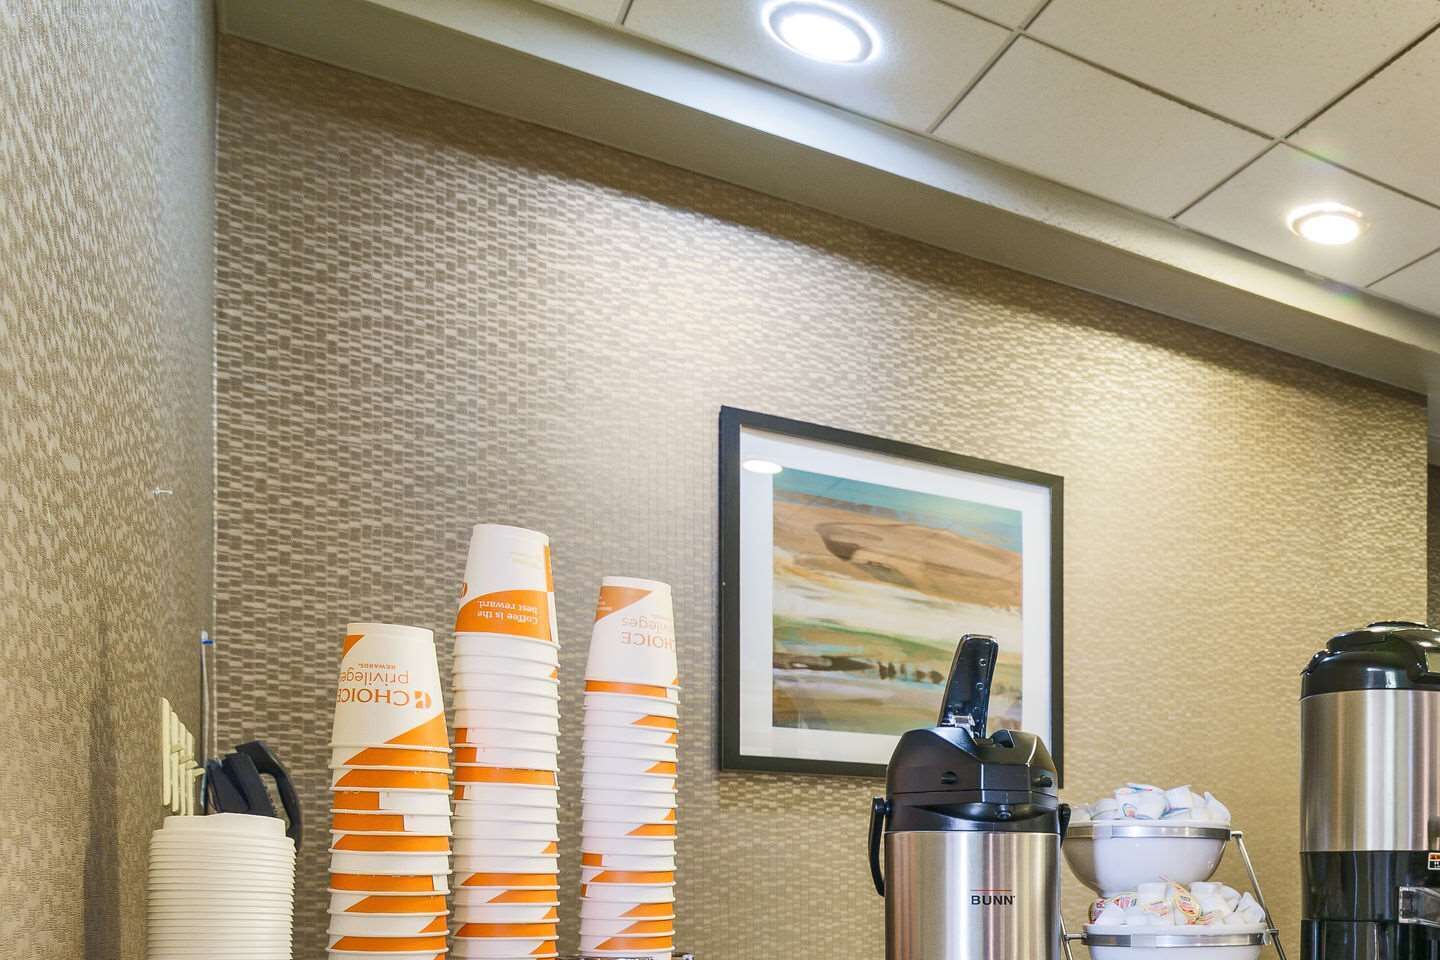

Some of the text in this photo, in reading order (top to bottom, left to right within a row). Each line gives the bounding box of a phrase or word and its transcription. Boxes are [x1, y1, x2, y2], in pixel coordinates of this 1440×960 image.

[495, 611, 504, 620] is
[506, 612, 539, 625] Coffee
[971, 895, 1014, 906] BUNN
